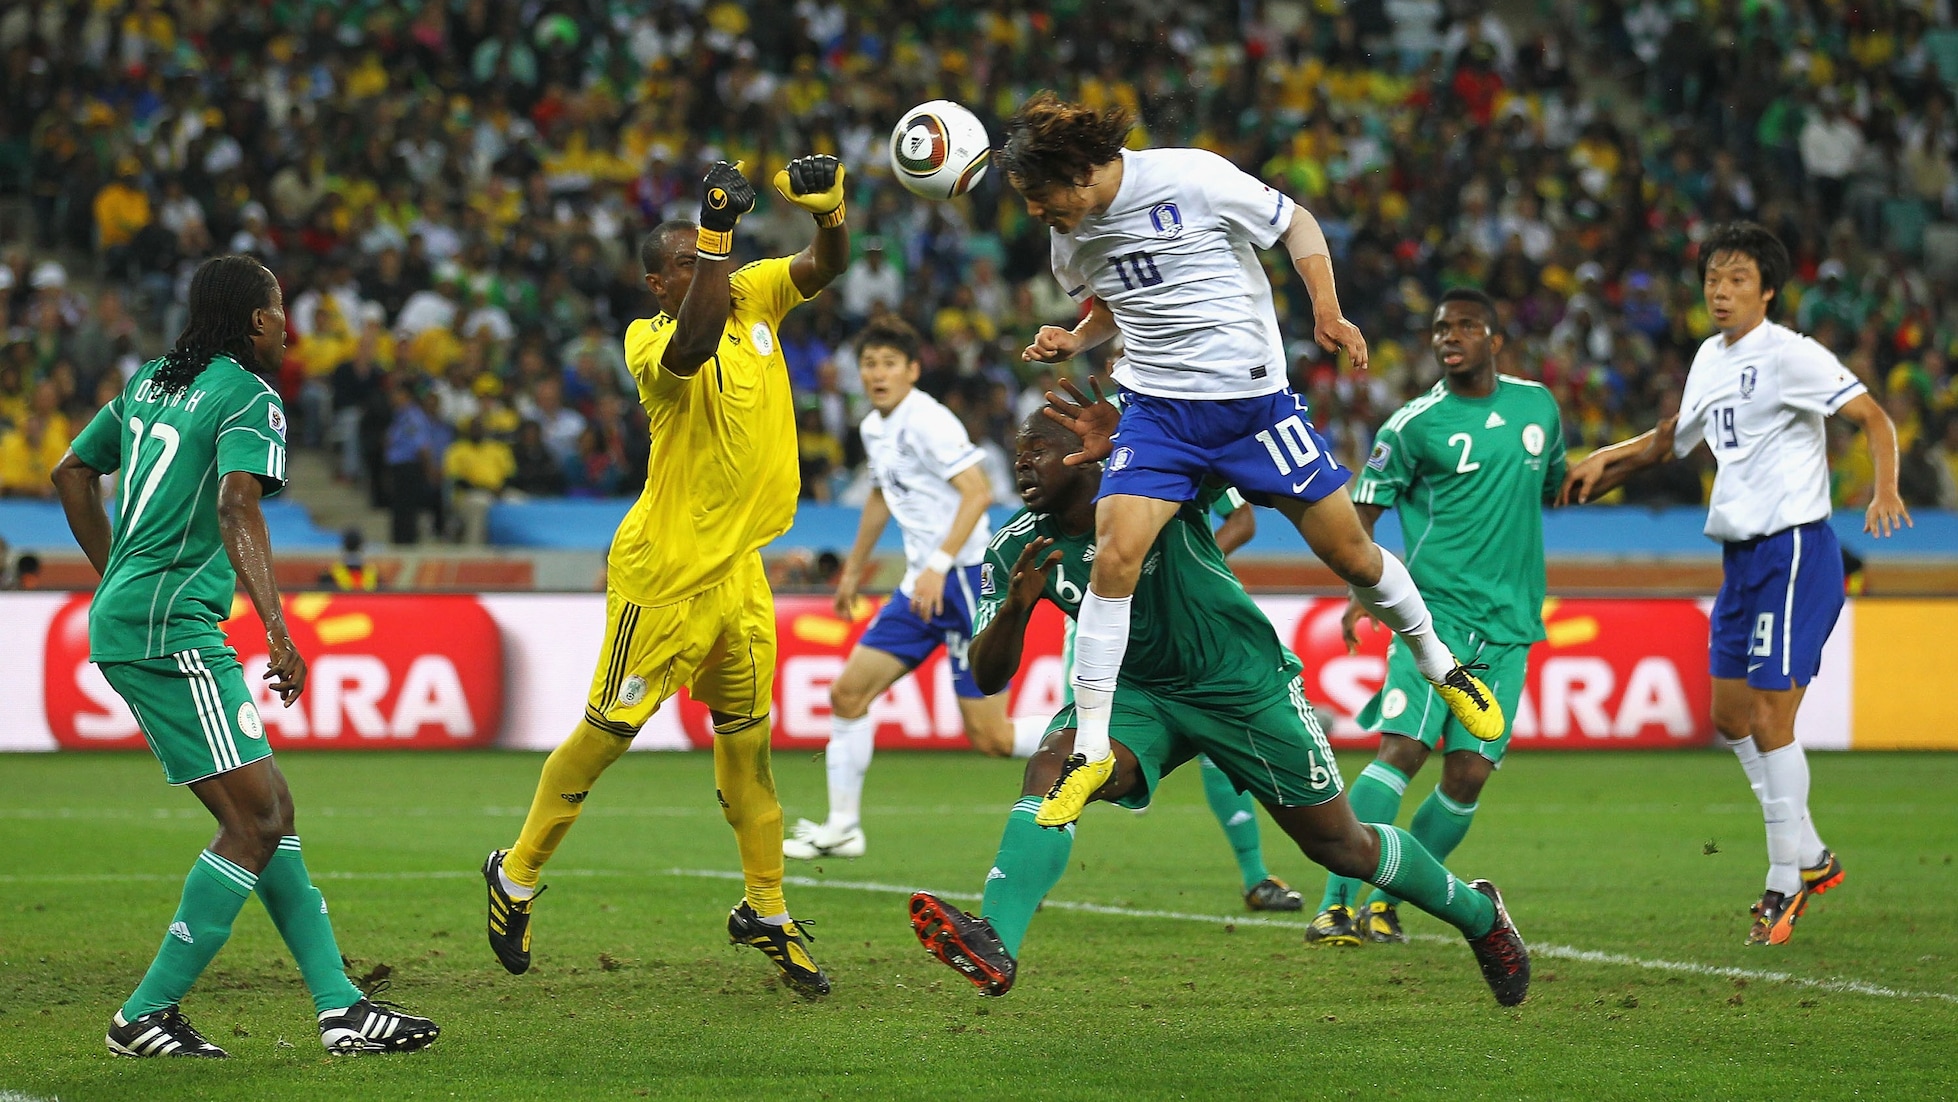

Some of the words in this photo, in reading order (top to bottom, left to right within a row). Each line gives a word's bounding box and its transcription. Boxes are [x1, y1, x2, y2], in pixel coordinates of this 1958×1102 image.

[1107, 250, 1164, 291] 10
[1254, 414, 1321, 476] 10
[1713, 407, 1739, 450] 19
[1448, 432, 1481, 474] 2
[120, 416, 180, 538] 17
[1056, 563, 1083, 604] 6
[73, 653, 477, 741] SARA
[1318, 655, 1694, 741] SRA
[1307, 749, 1331, 790] 6
